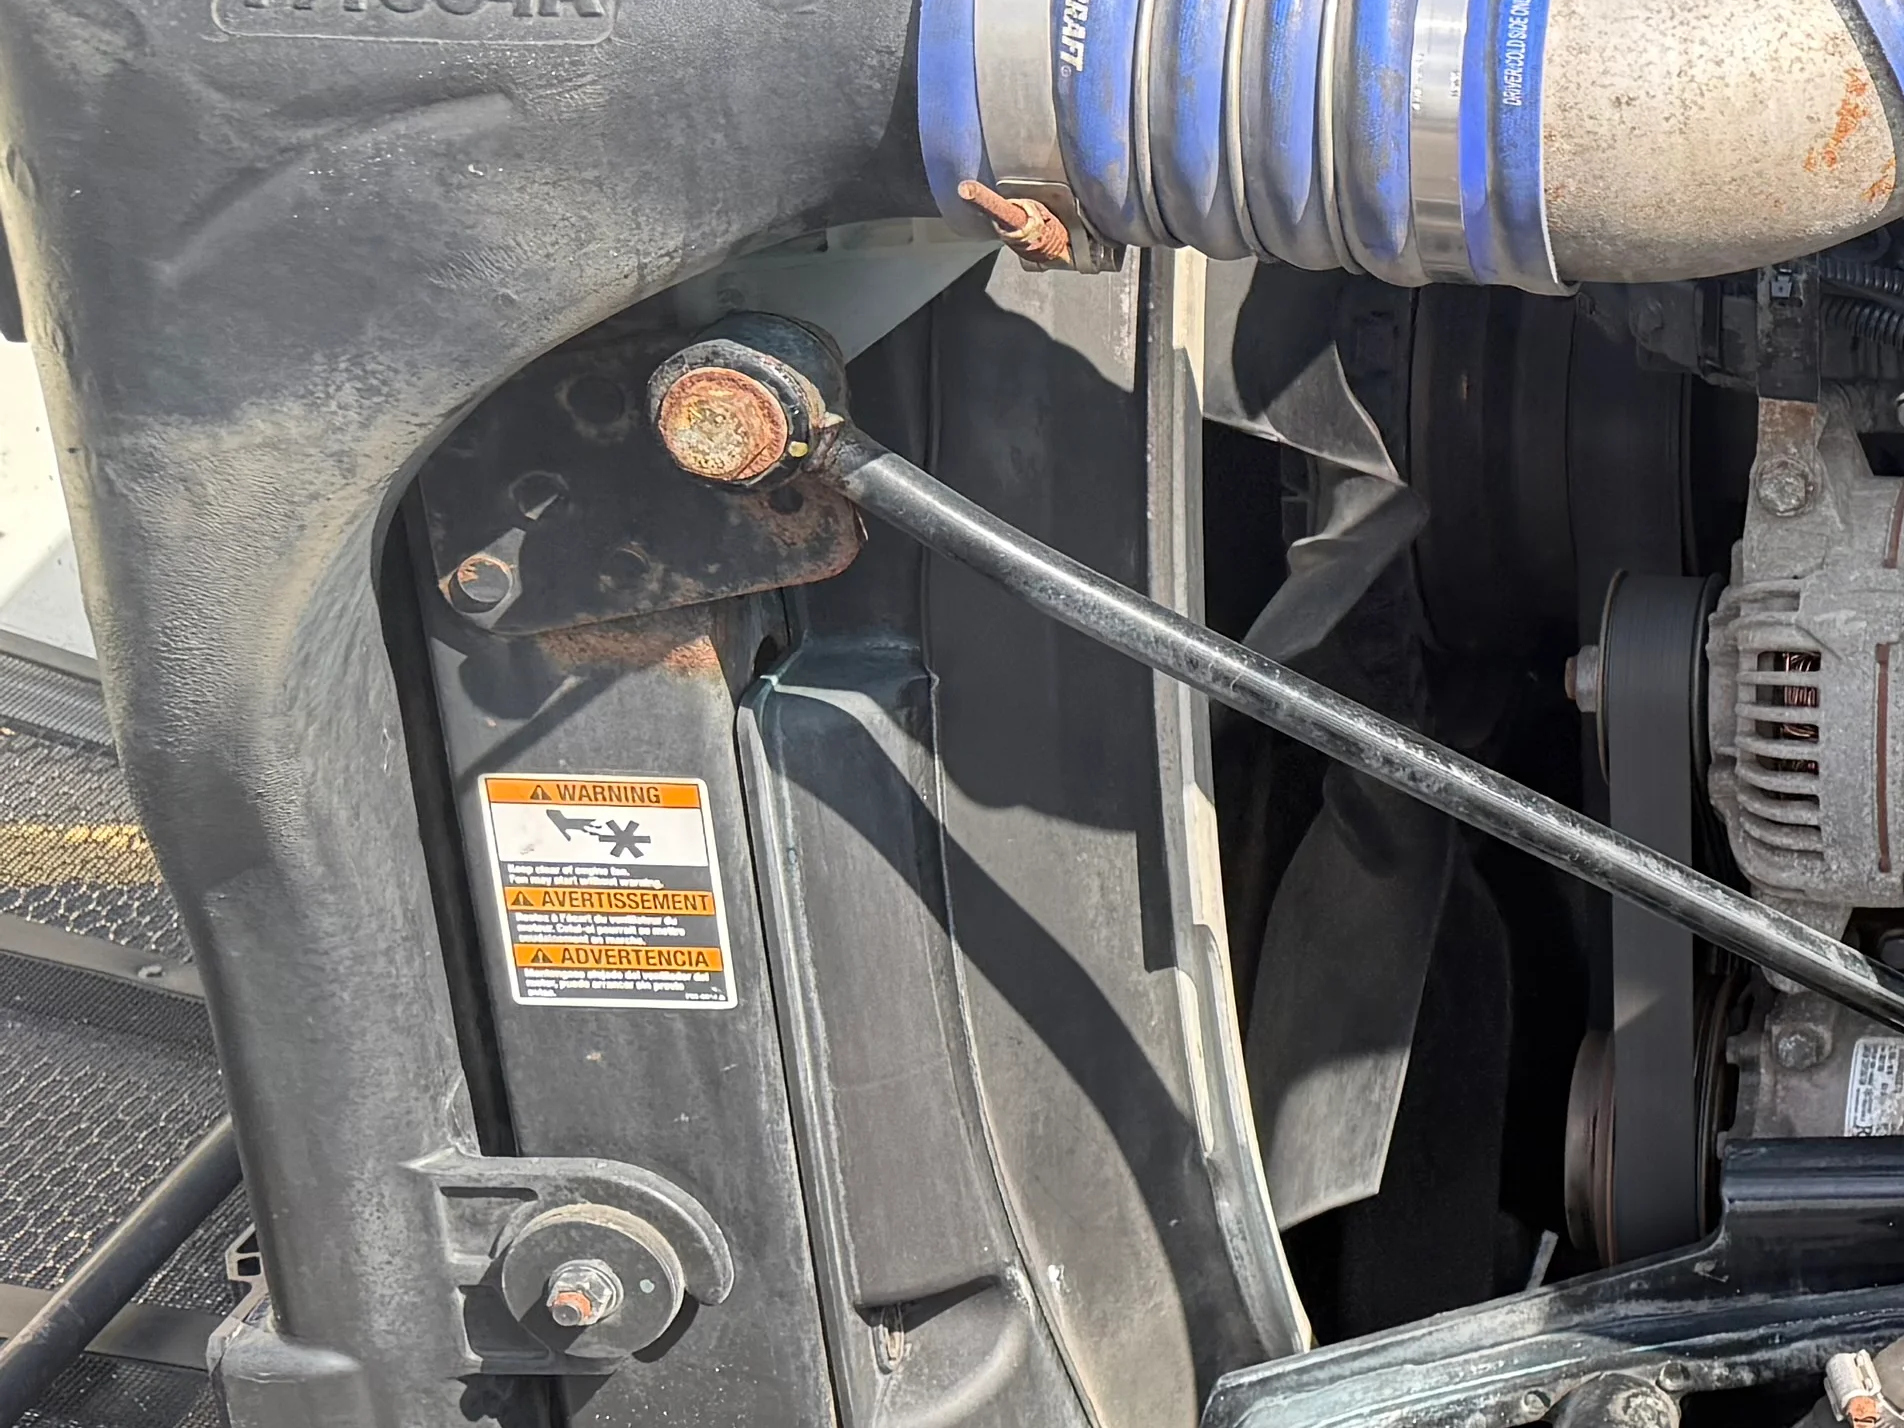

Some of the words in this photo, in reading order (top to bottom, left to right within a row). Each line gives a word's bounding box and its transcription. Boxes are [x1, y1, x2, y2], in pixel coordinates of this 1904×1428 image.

[556, 784, 661, 804] WARNING
[542, 891, 709, 911] AVERTISSEMENT
[561, 947, 709, 967] ADVERTENCIA
